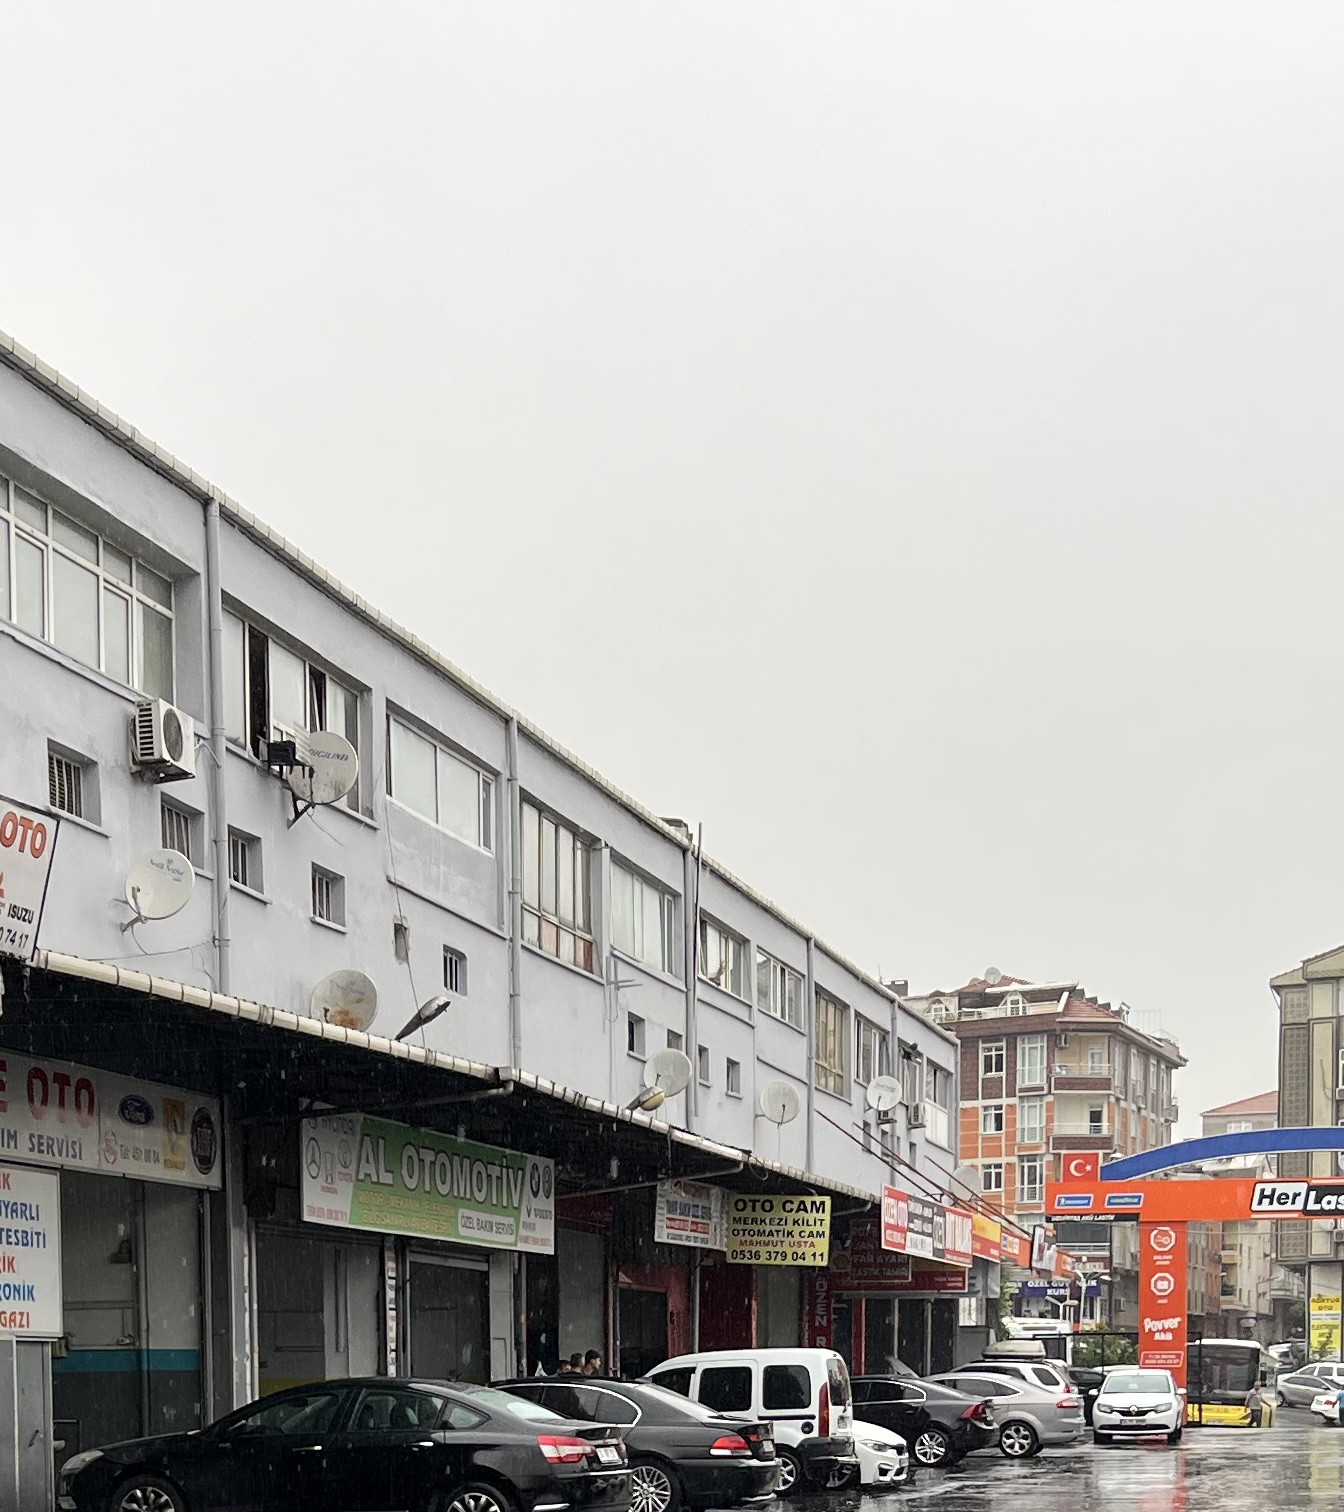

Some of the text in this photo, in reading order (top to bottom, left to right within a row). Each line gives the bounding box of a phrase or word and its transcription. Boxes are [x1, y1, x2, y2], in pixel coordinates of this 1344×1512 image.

[0, 811, 47, 859] OTO
[7, 903, 34, 924] ISUZU
[6, 929, 16, 946] 74
[18, 933, 29, 950] 17
[27, 1067, 95, 1128] OTO
[29, 1133, 83, 1161] SERVİSİ
[357, 1134, 524, 1209] AL OTOMOTİV
[734, 1198, 826, 1214] OTO CAM
[1257, 1187, 1302, 1207] Her
[732, 1216, 826, 1227] MERKEZİ KİLİT
[731, 1228, 826, 1239] OTOMATİK CAM
[739, 1239, 816, 1249] MAHMUT USTA
[731, 1249, 825, 1262] 0536 379 04 11
[0, 1312, 30, 1329] GAZI
